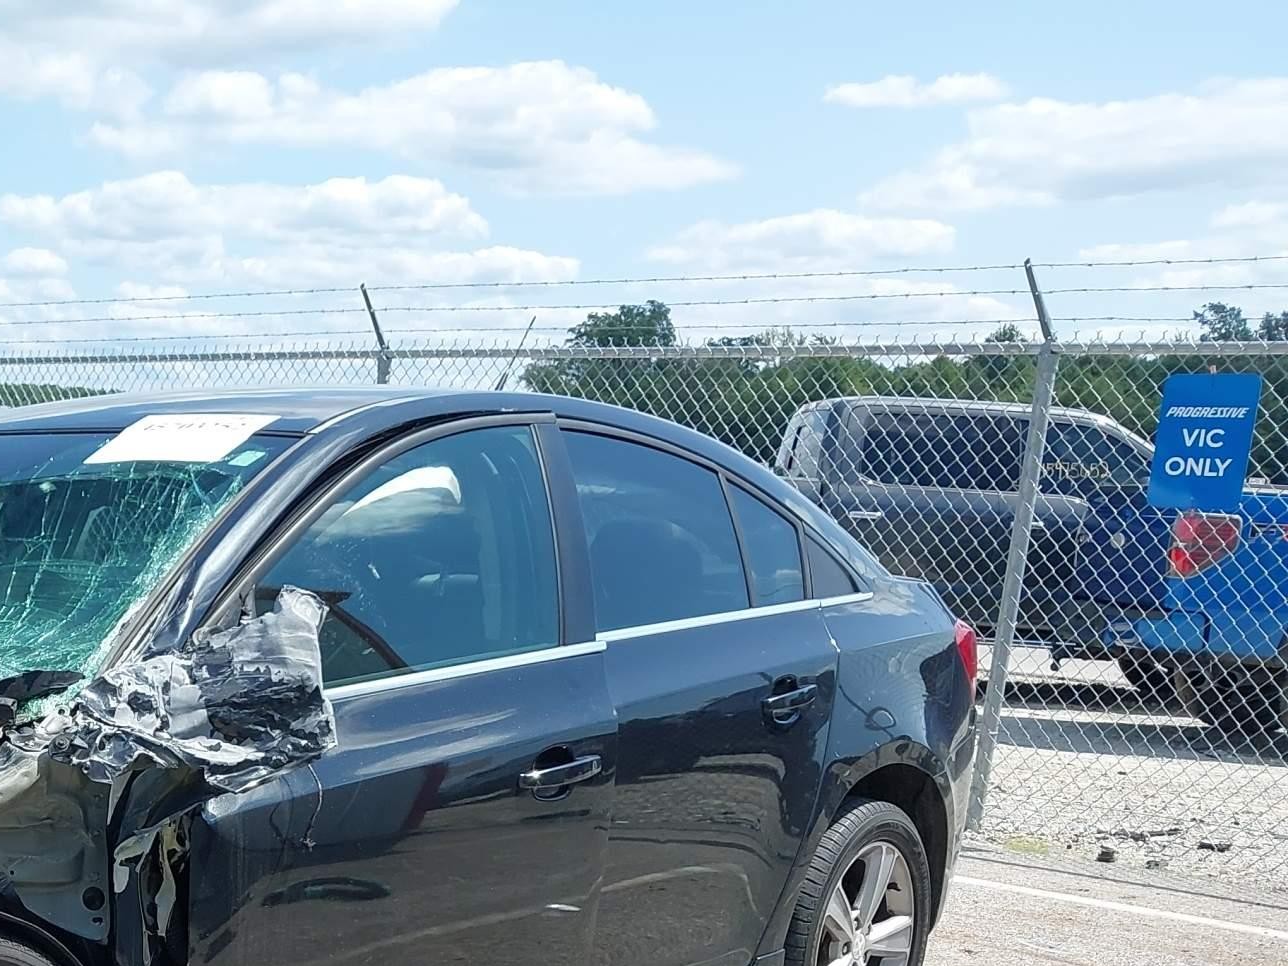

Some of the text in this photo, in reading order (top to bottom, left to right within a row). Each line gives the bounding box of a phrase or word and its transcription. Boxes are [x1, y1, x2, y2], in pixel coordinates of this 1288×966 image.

[1165, 406, 1250, 418] PROGRESSIVE
[1182, 428, 1225, 448] VIC
[1164, 456, 1233, 477] ONLY
